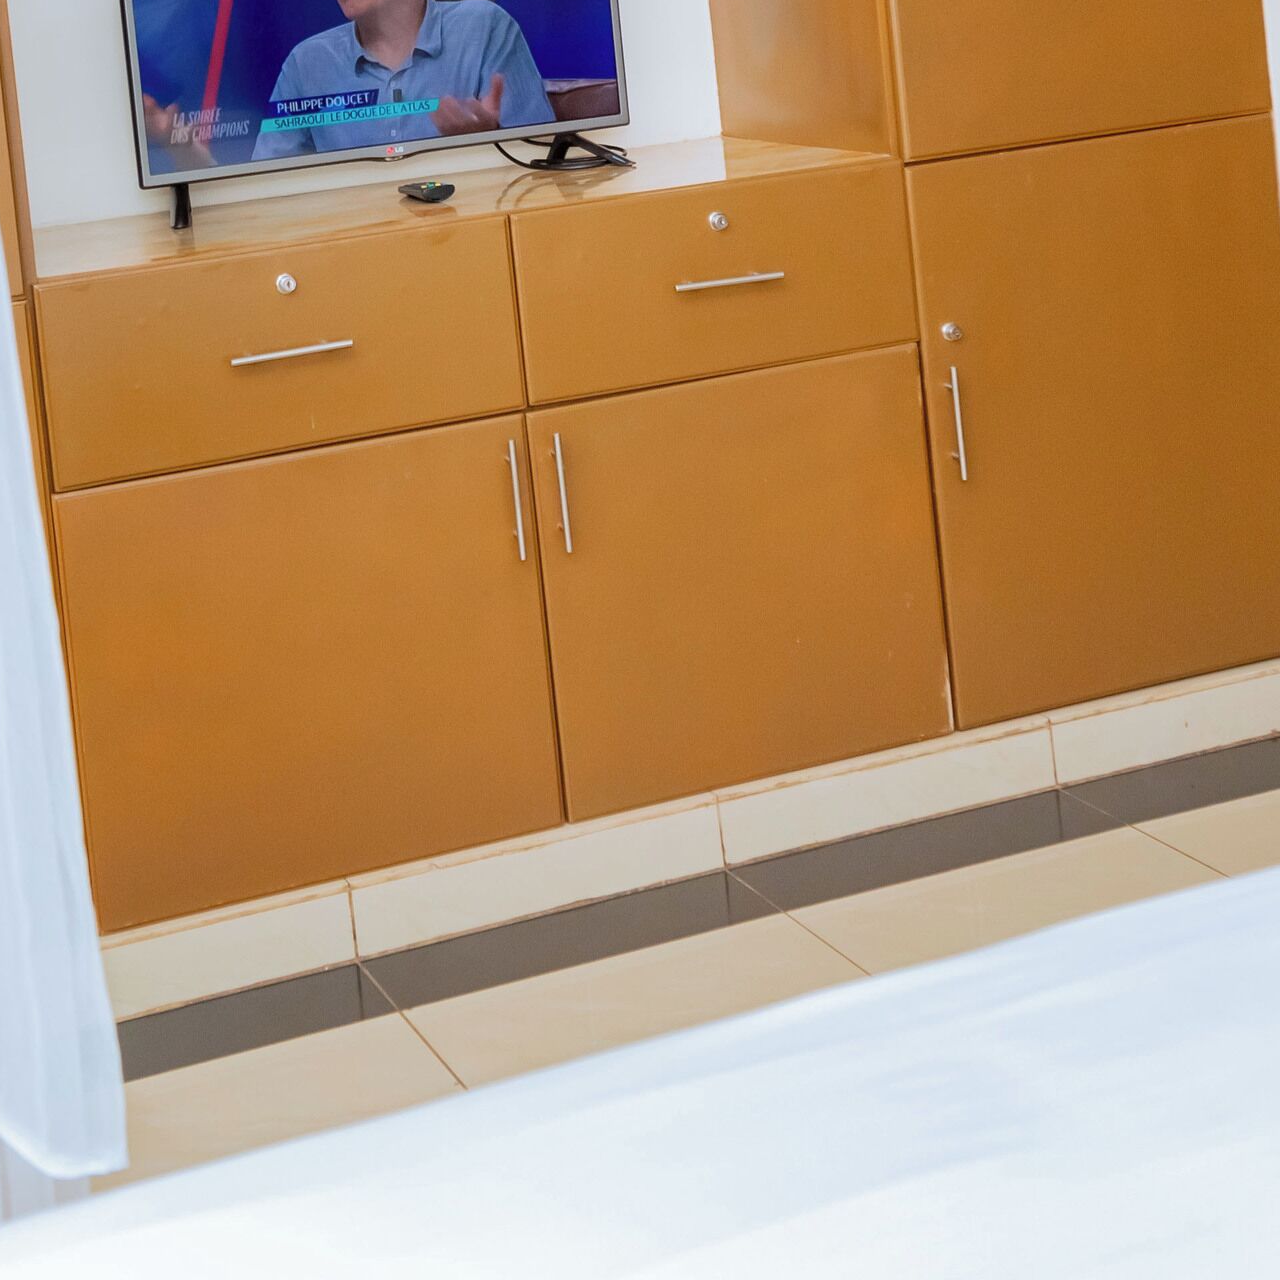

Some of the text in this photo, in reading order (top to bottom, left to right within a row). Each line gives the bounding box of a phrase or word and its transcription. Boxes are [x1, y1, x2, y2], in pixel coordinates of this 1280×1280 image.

[276, 92, 371, 114] PHILIPPE DOUCET
[172, 111, 185, 128] LA
[331, 111, 341, 122] LE
[343, 107, 377, 121] DOGUE
[379, 106, 392, 116] DE
[192, 119, 250, 141] CHAMPIONS
